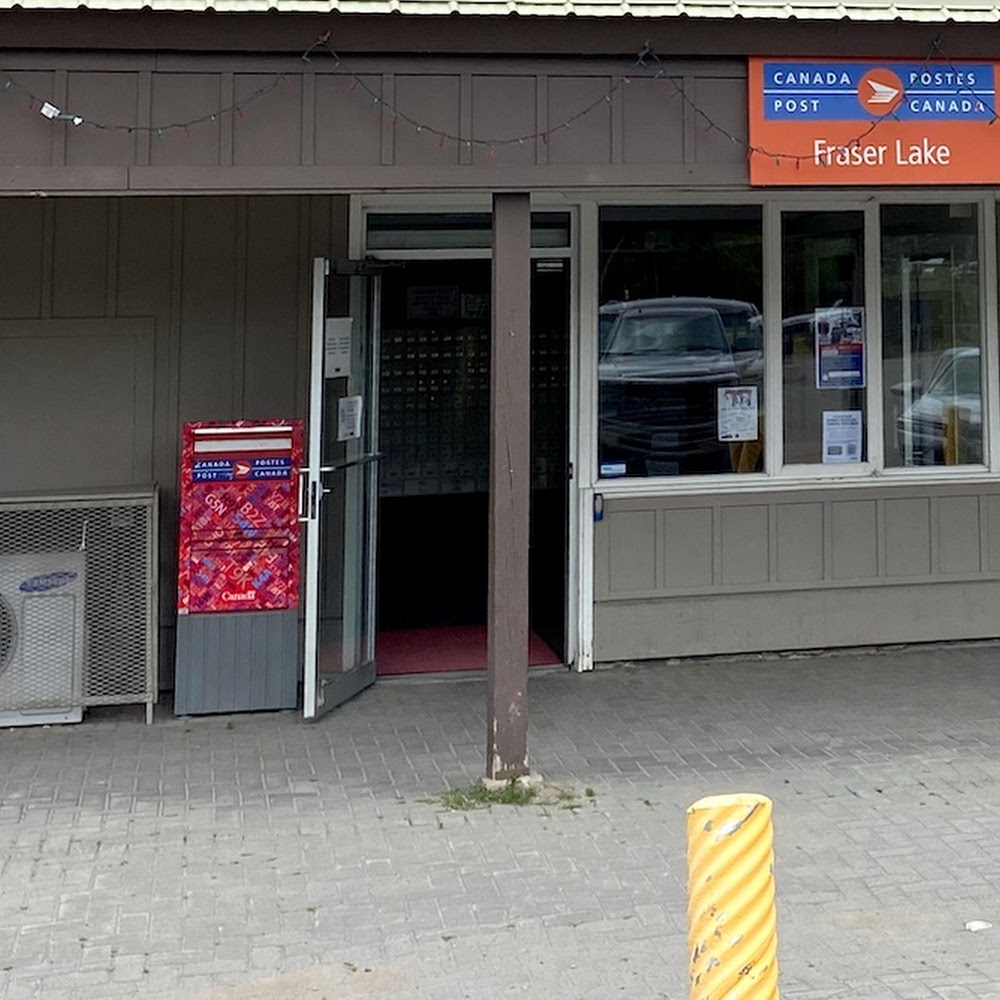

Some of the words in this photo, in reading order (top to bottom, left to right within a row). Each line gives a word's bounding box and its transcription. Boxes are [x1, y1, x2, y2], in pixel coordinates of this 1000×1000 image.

[773, 72, 852, 85] CANADA
[909, 73, 976, 86] POSTES
[774, 100, 820, 112] POST
[910, 100, 985, 113] CANADA
[814, 140, 887, 166] Fraser
[896, 138, 950, 165] Lake
